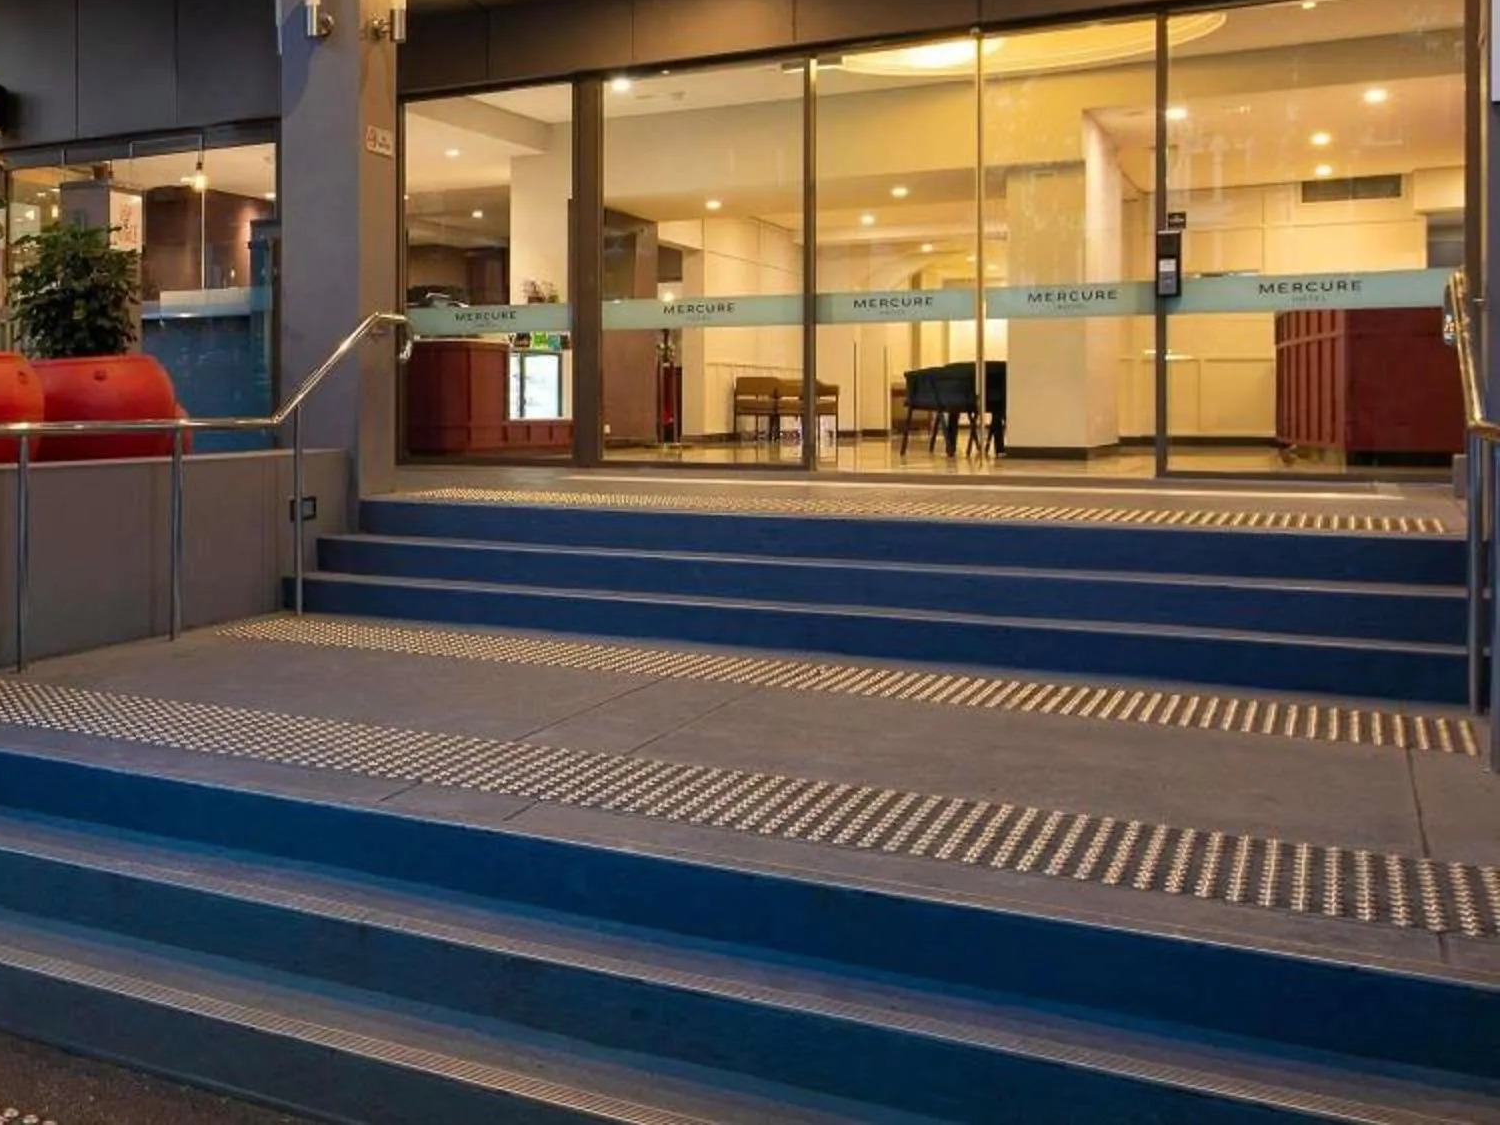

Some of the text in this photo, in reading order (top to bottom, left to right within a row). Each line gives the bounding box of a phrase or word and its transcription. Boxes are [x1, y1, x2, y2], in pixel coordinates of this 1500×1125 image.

[1258, 279, 1363, 295] MERCURE
[852, 296, 934, 309] MERCURE
[1027, 289, 1118, 303] MERCURE
[662, 302, 735, 315] MERCURE
[454, 310, 517, 322] MERCURE
